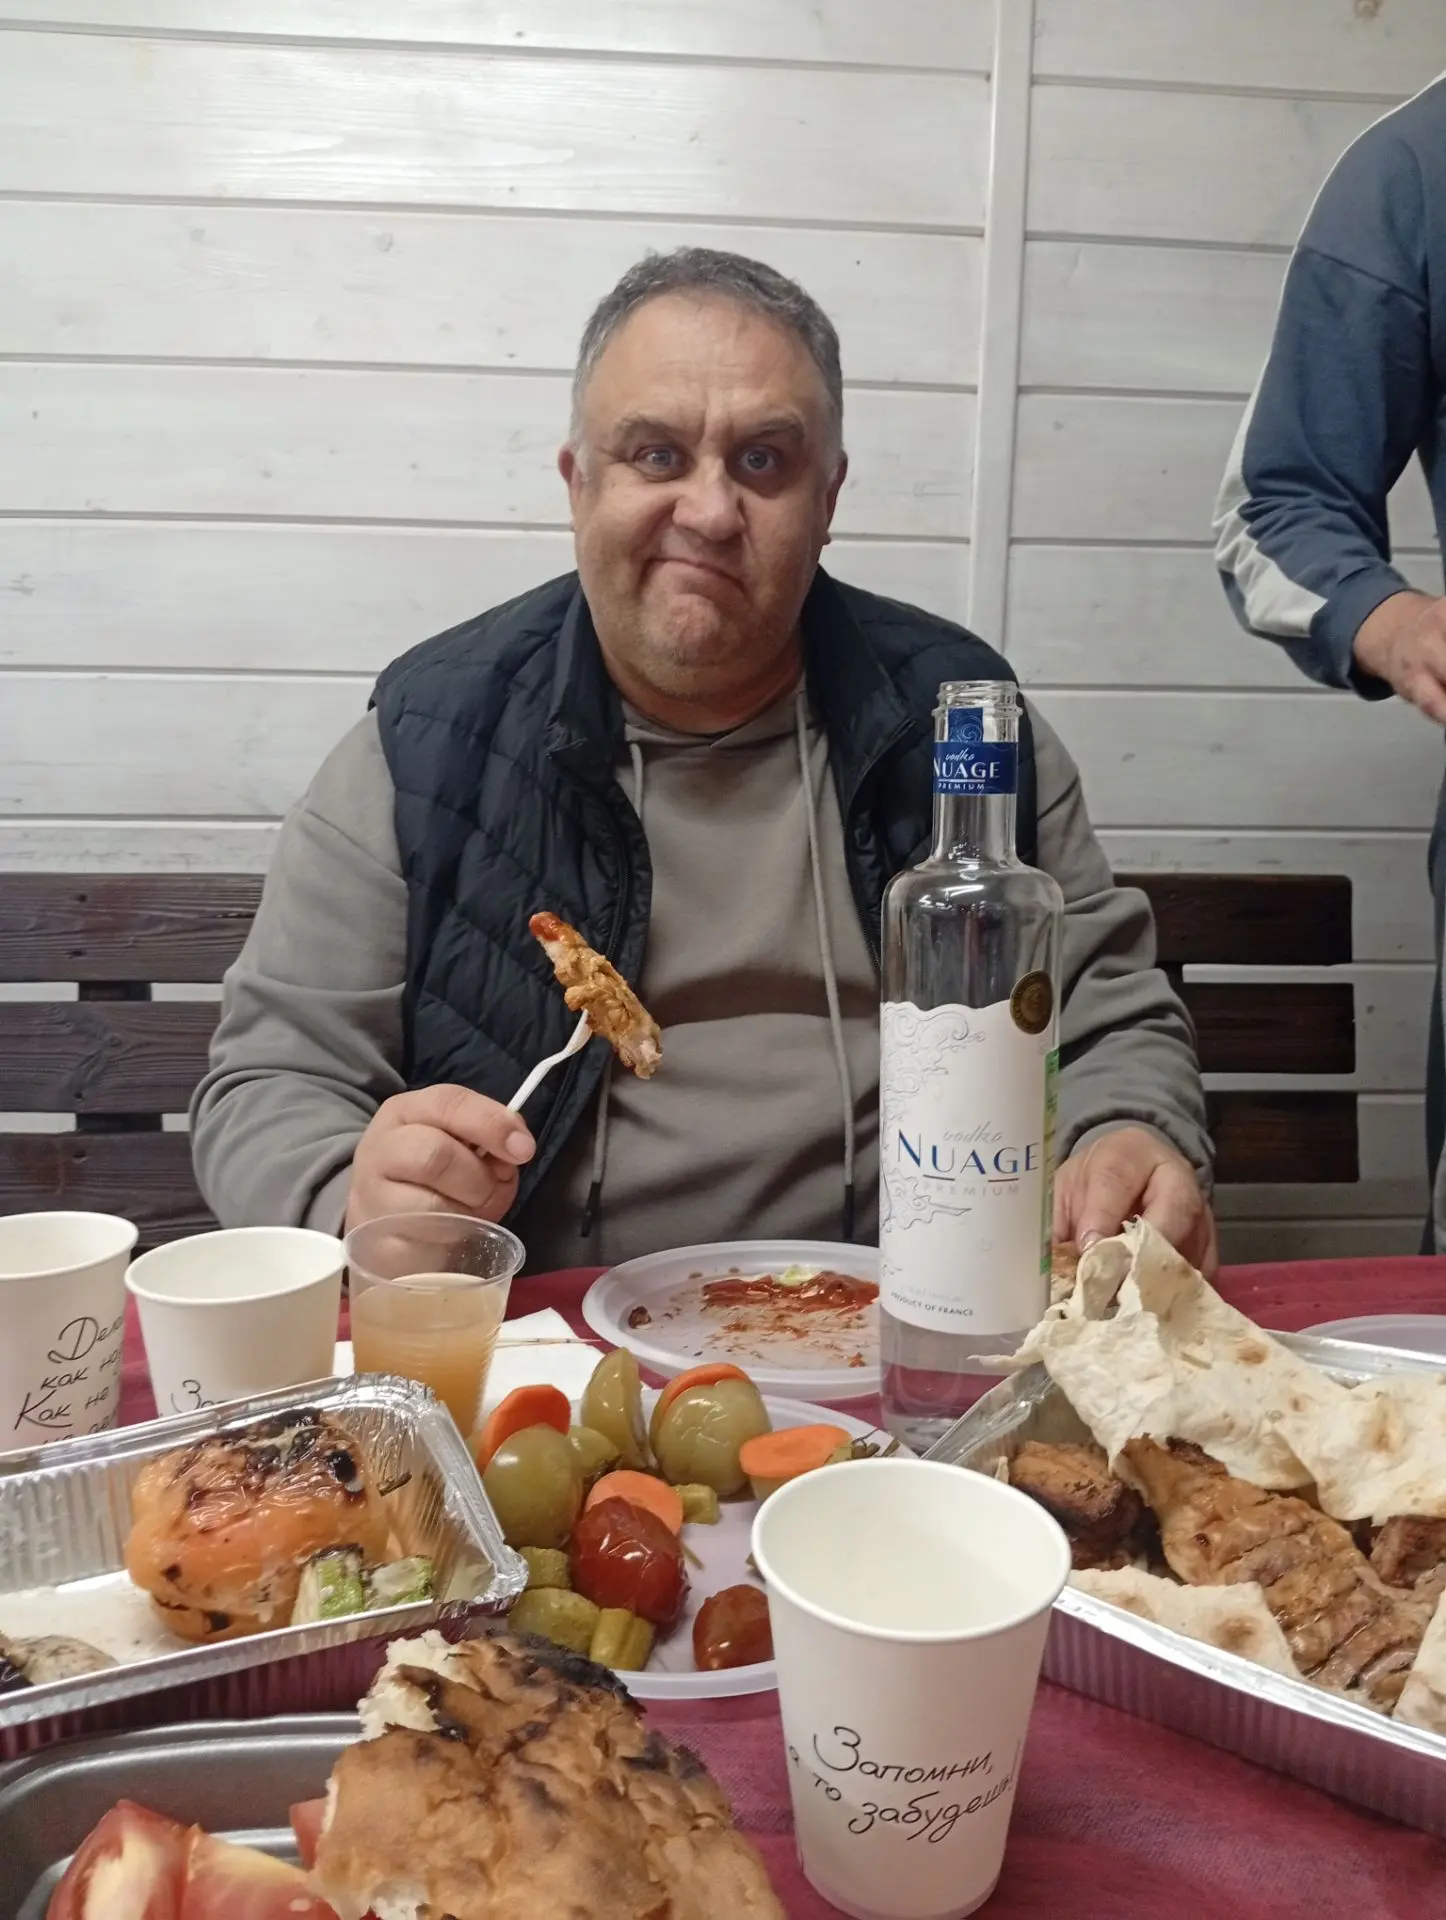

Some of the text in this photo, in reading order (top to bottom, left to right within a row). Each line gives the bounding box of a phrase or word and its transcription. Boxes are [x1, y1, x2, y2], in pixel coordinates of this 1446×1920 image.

[933, 757, 1000, 778] NUAGE
[898, 1129, 1040, 1175] NUAGE
[923, 1181, 1020, 1197] PREMIUM
[891, 1292, 922, 1309] PRODUCT
[924, 1302, 936, 1312] OF
[938, 1306, 974, 1317] FRANCE
[40, 1367, 89, 1390] как
[14, 1389, 73, 1430] Как
[813, 1726, 993, 1784] Запомни,
[812, 1772, 842, 1801] то
